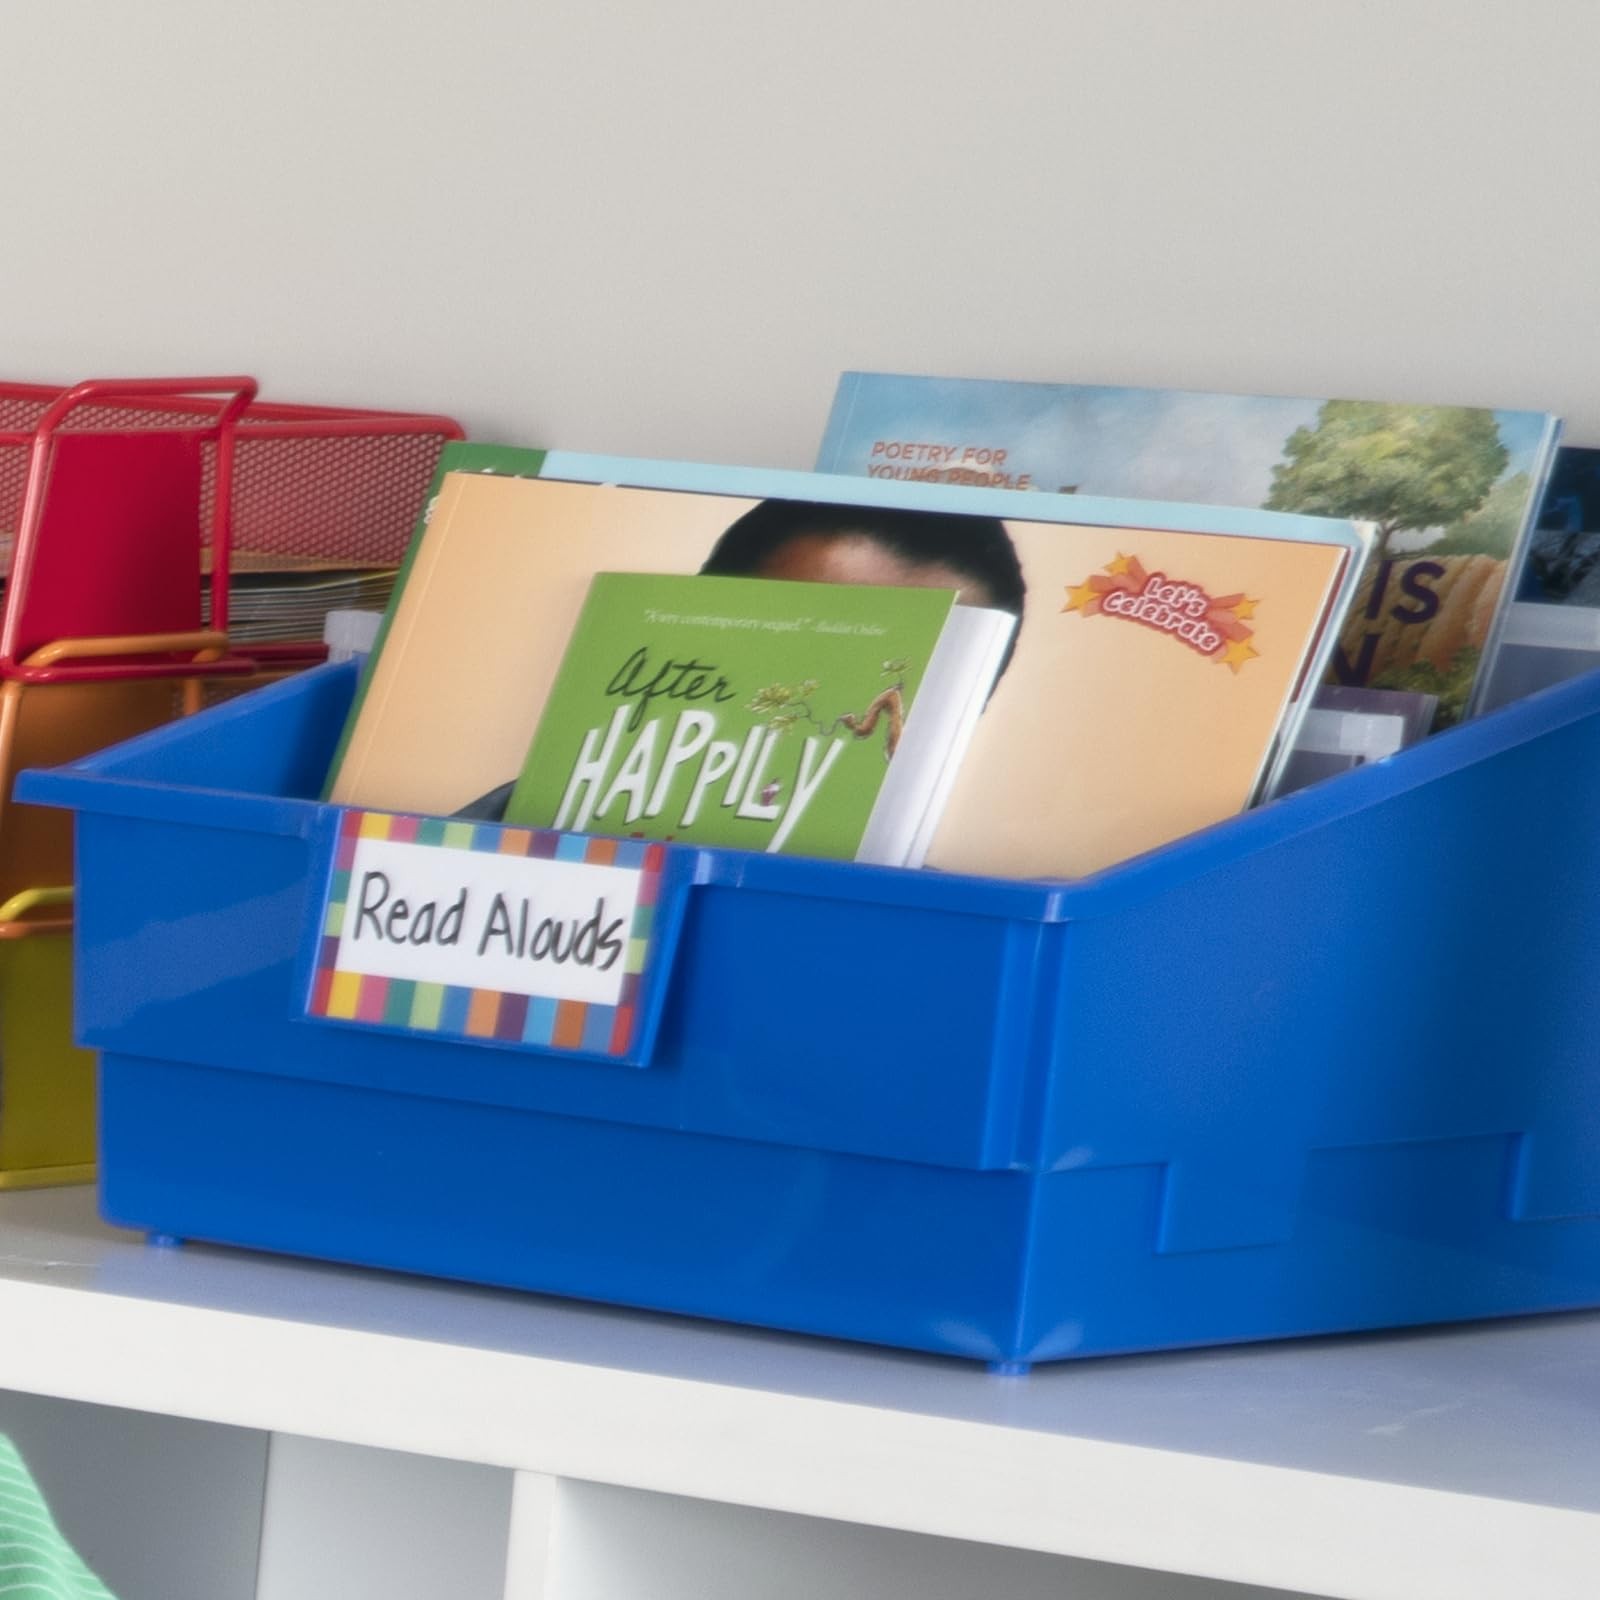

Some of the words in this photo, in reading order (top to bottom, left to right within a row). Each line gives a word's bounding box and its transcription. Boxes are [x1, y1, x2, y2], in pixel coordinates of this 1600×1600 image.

[867, 463, 942, 482] YOUNG
[947, 468, 1032, 491] PEOPLE
[871, 441, 957, 463] POETRY
[961, 447, 1008, 466] FOR
[1102, 591, 1221, 651] Celebrate
[1144, 576, 1207, 617] Let's
[605, 646, 736, 733] After
[552, 704, 845, 854] HAPPILY
[353, 870, 469, 947] Read
[477, 891, 625, 972] Alouds
